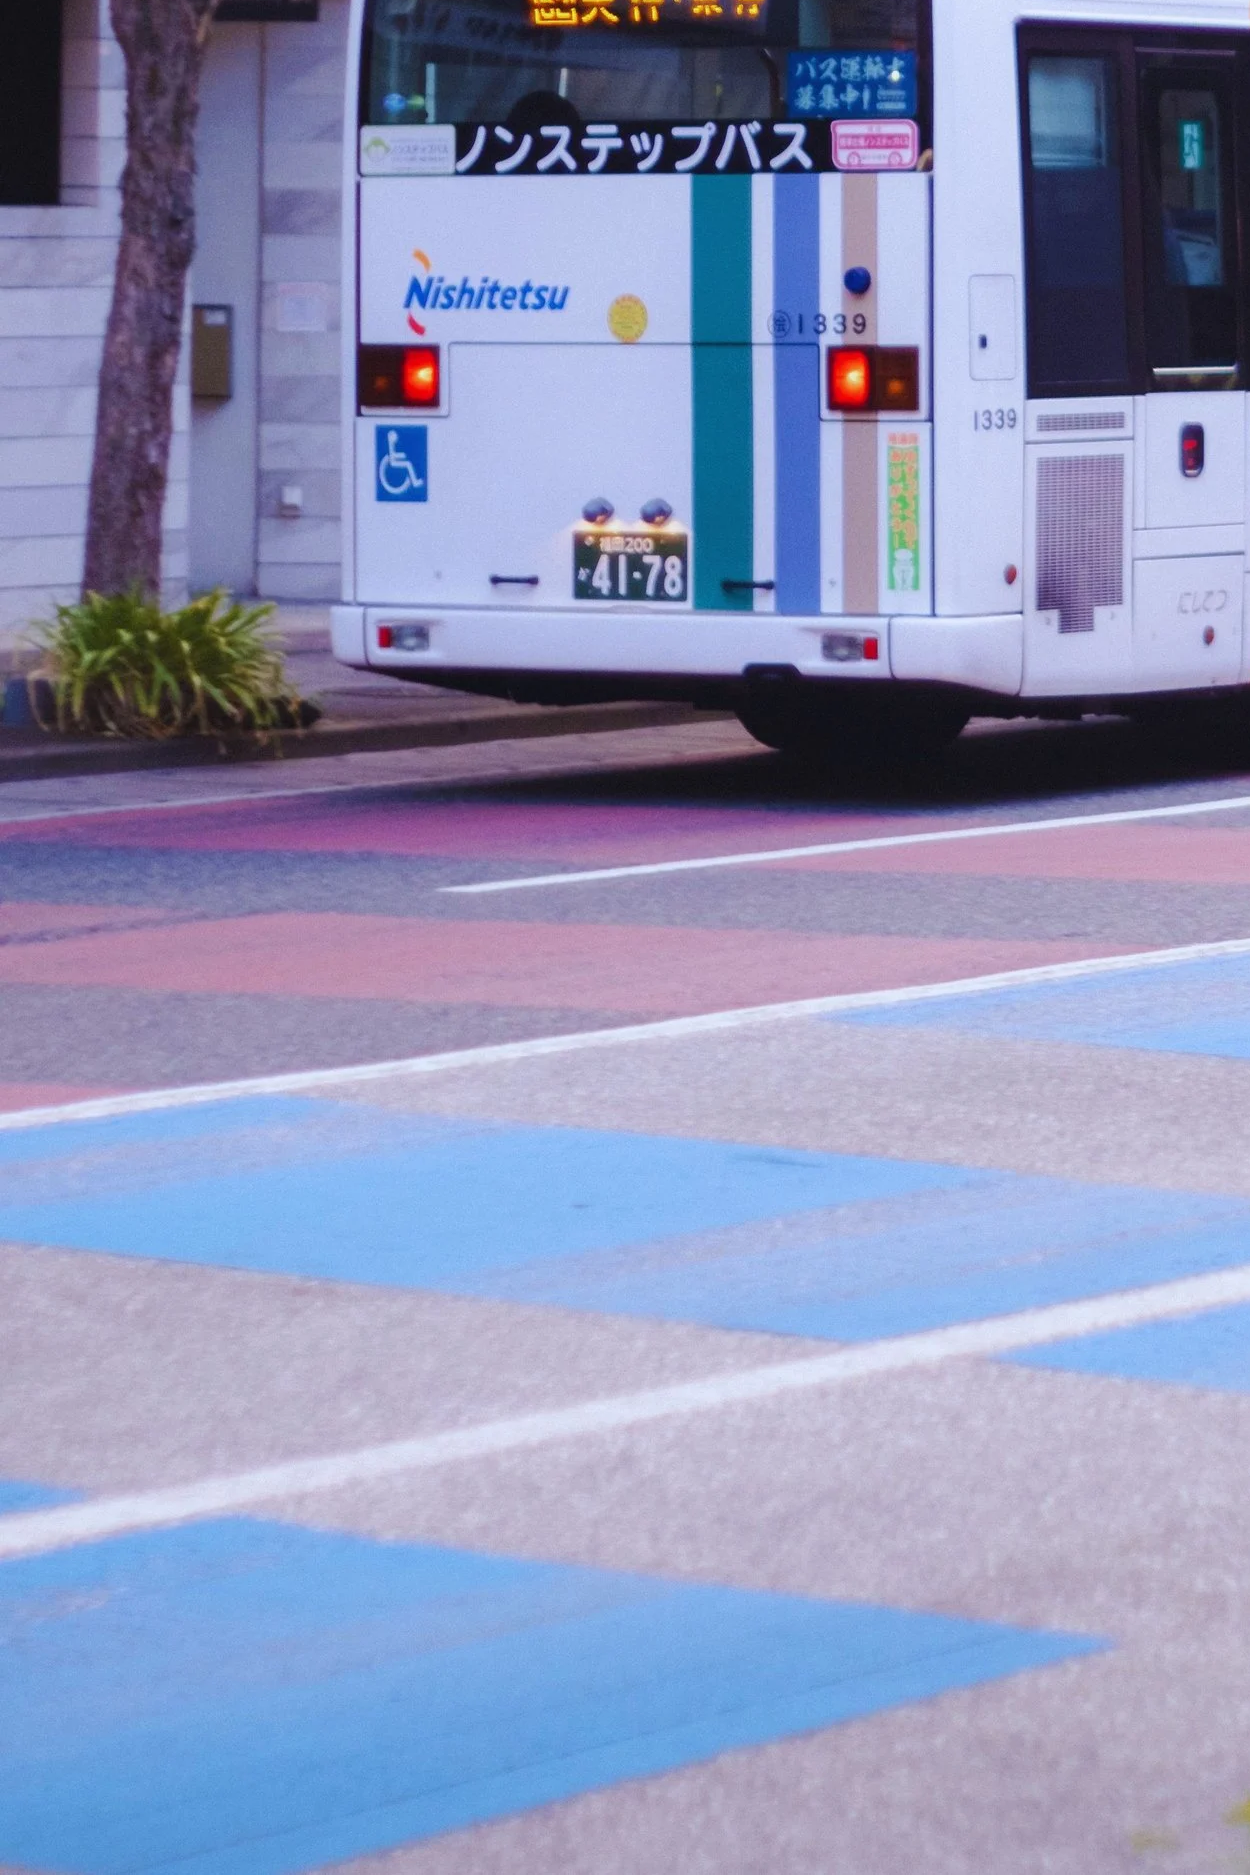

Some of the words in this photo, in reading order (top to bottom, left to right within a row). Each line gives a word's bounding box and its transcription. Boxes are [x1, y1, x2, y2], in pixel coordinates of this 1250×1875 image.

[455, 122, 813, 172] ノンステップバス
[403, 276, 569, 311] Nishitetsu
[798, 312, 866, 335] 1339
[973, 408, 1017, 431] 1339
